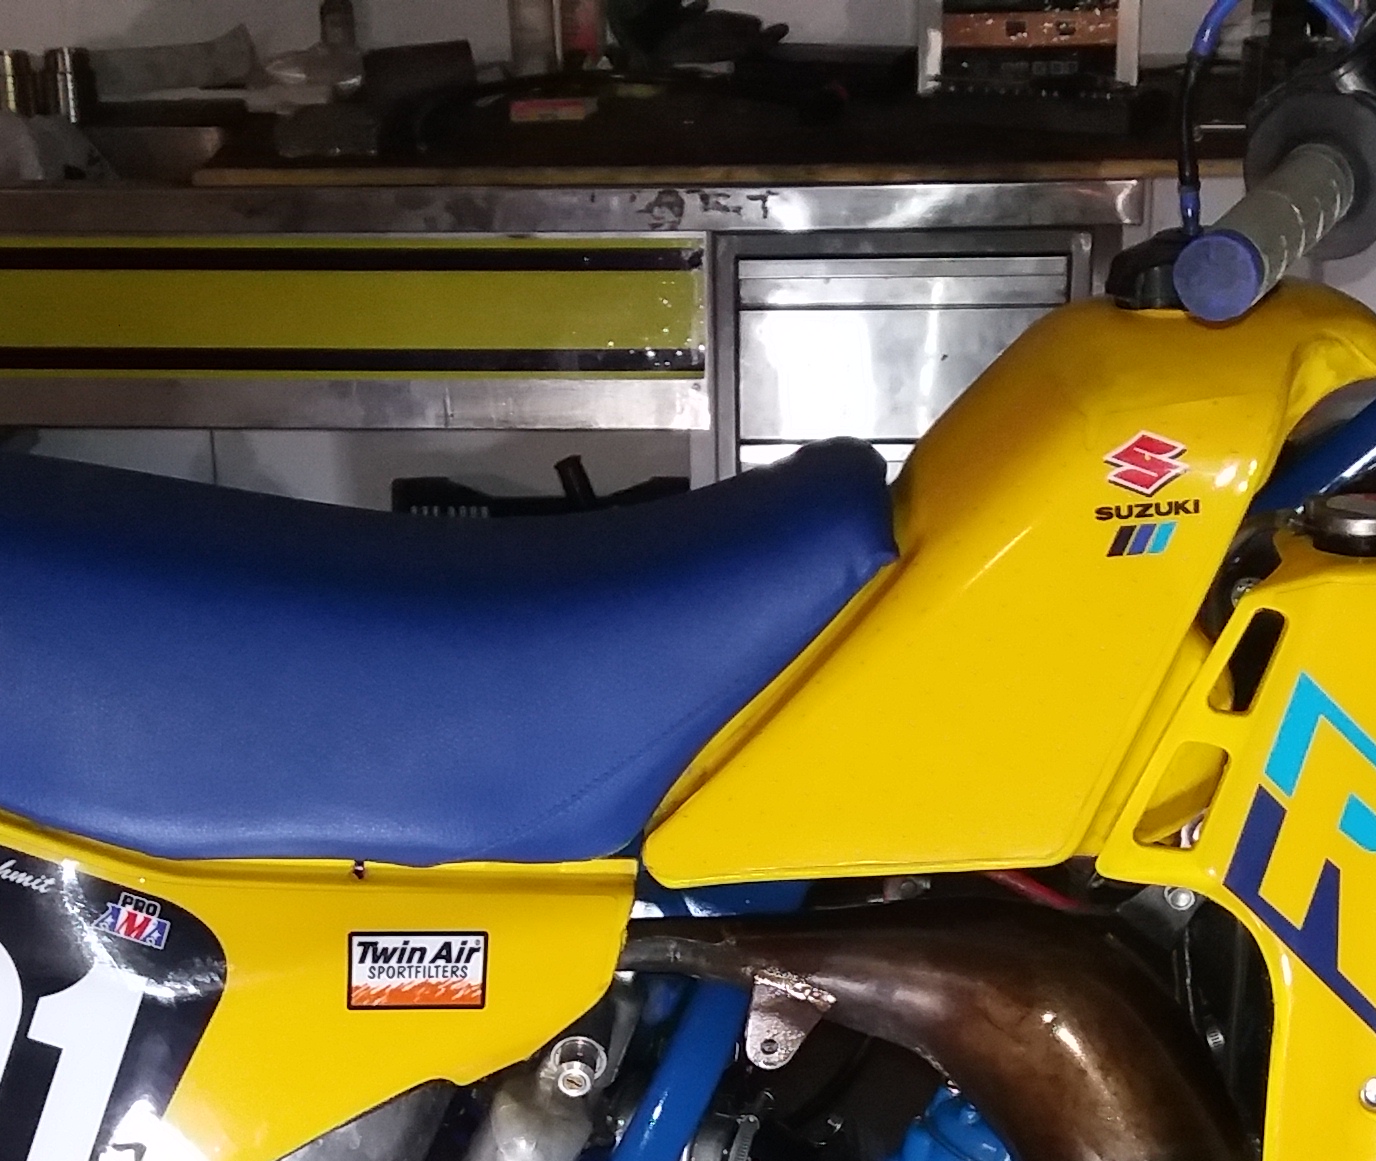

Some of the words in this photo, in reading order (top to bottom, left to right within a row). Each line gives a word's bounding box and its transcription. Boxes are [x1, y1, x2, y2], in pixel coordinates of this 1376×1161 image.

[1094, 499, 1200, 521] SUZUKI
[123, 894, 159, 918] PRO
[94, 902, 169, 949] AMA
[357, 940, 427, 964] Twin
[429, 940, 481, 964] Air
[367, 965, 468, 979] SPORTFILTERS
